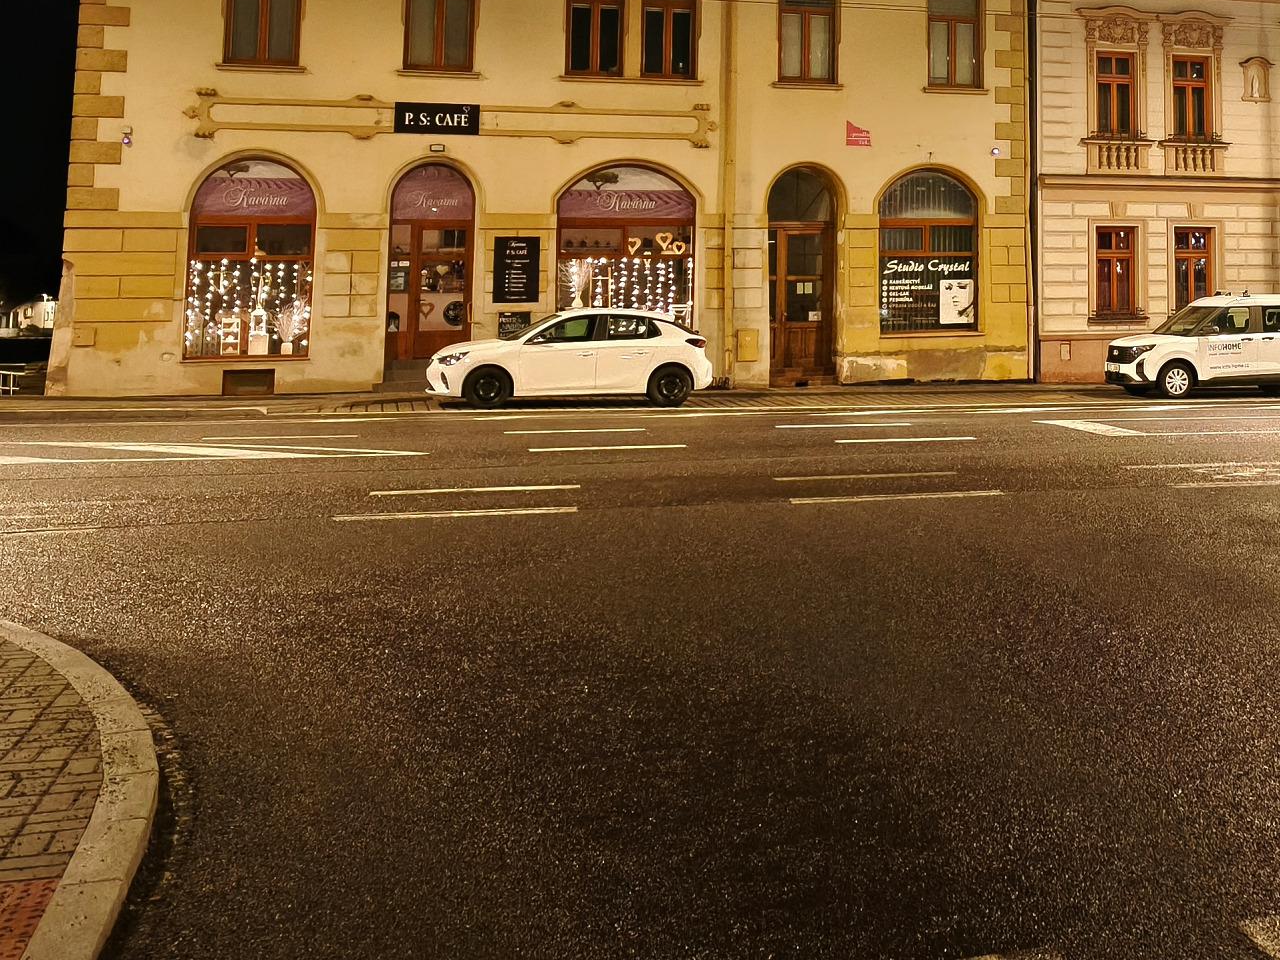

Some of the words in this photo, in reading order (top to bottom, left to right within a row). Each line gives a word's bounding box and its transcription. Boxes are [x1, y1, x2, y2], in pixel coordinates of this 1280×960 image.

[405, 112, 414, 125] P.
[419, 113, 431, 126] S:
[223, 187, 289, 208] Kavárna
[597, 191, 656, 211] Kavárna
[883, 260, 925, 275] Studio
[928, 260, 970, 275] Crystal
